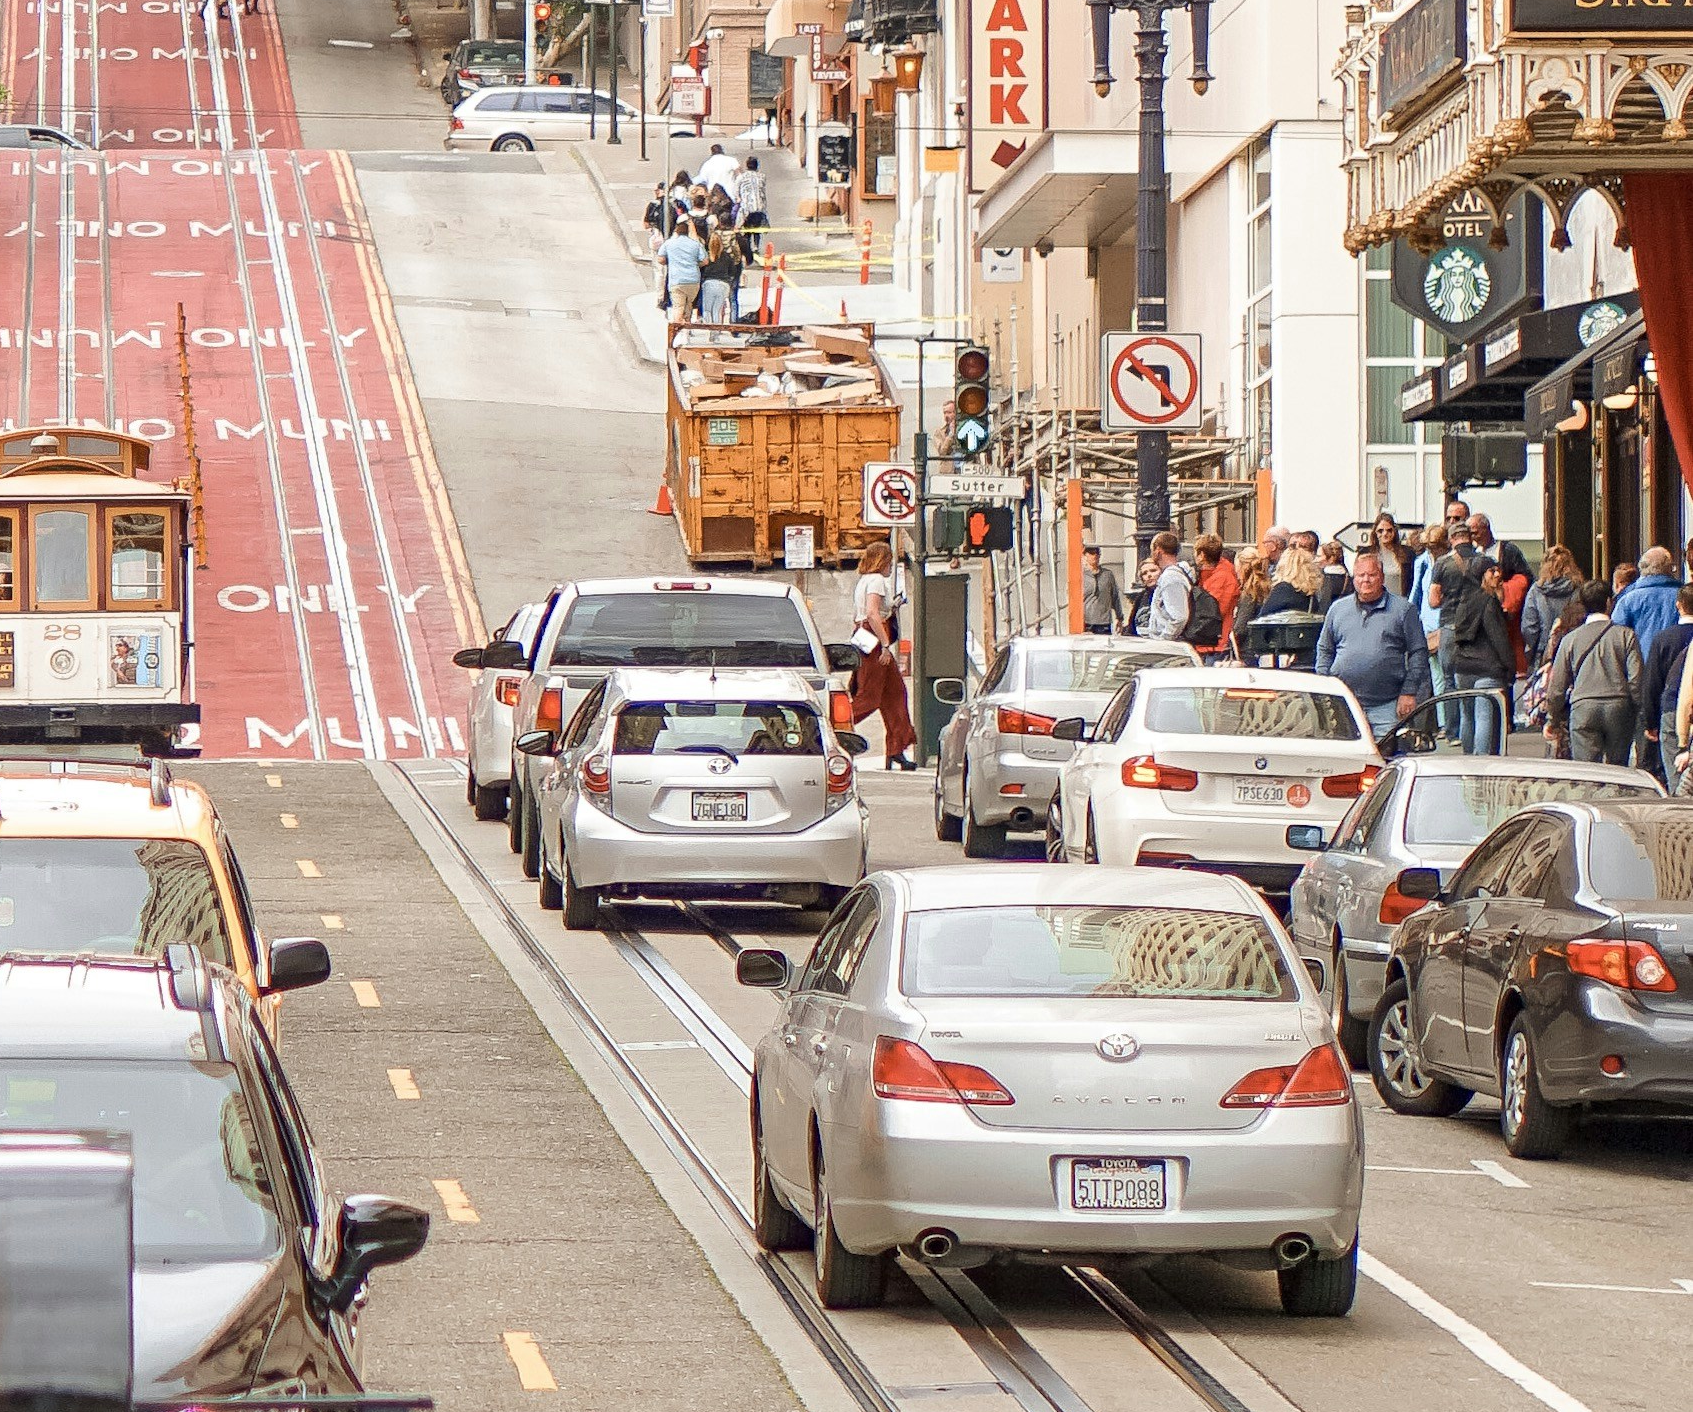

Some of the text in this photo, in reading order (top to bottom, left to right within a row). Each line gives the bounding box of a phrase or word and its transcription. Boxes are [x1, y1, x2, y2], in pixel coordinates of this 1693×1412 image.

[799, 24, 822, 34] LAST
[812, 71, 847, 80] TAVERN
[1443, 223, 1484, 237] OTEL
[951, 480, 1004, 493] Sutter
[217, 585, 433, 612] ONLY
[43, 624, 82, 641] 28
[245, 717, 466, 751] MUNI
[1099, 1159, 1138, 1168] TOYOTA
[1075, 1199, 1163, 1208] SAN FRANCISCO
